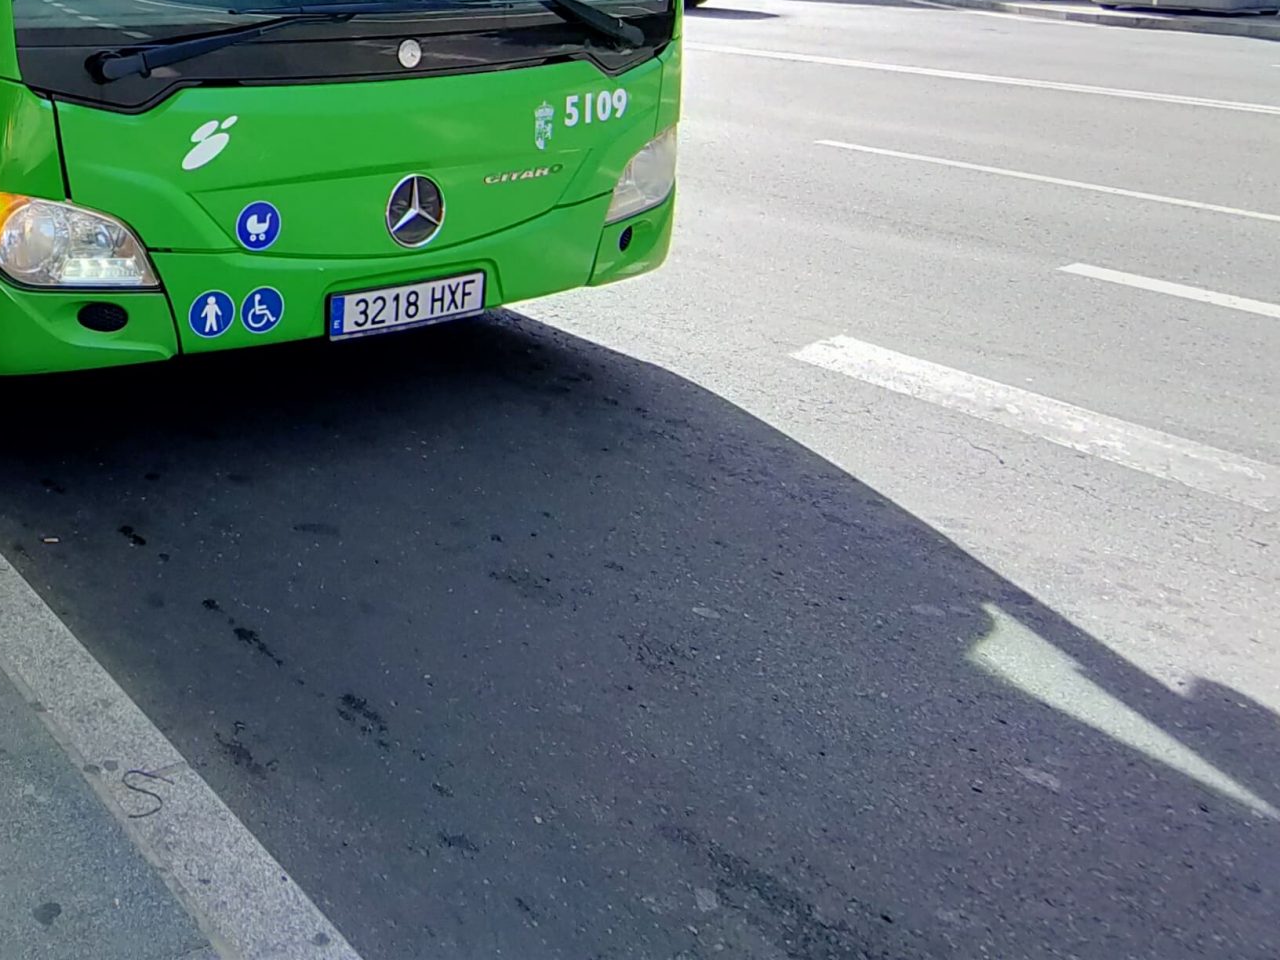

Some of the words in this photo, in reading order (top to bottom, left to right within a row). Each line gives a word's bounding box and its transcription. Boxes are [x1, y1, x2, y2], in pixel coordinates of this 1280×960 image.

[564, 88, 628, 127] 5109
[353, 290, 420, 328] 3218
[429, 279, 476, 316] HXF
